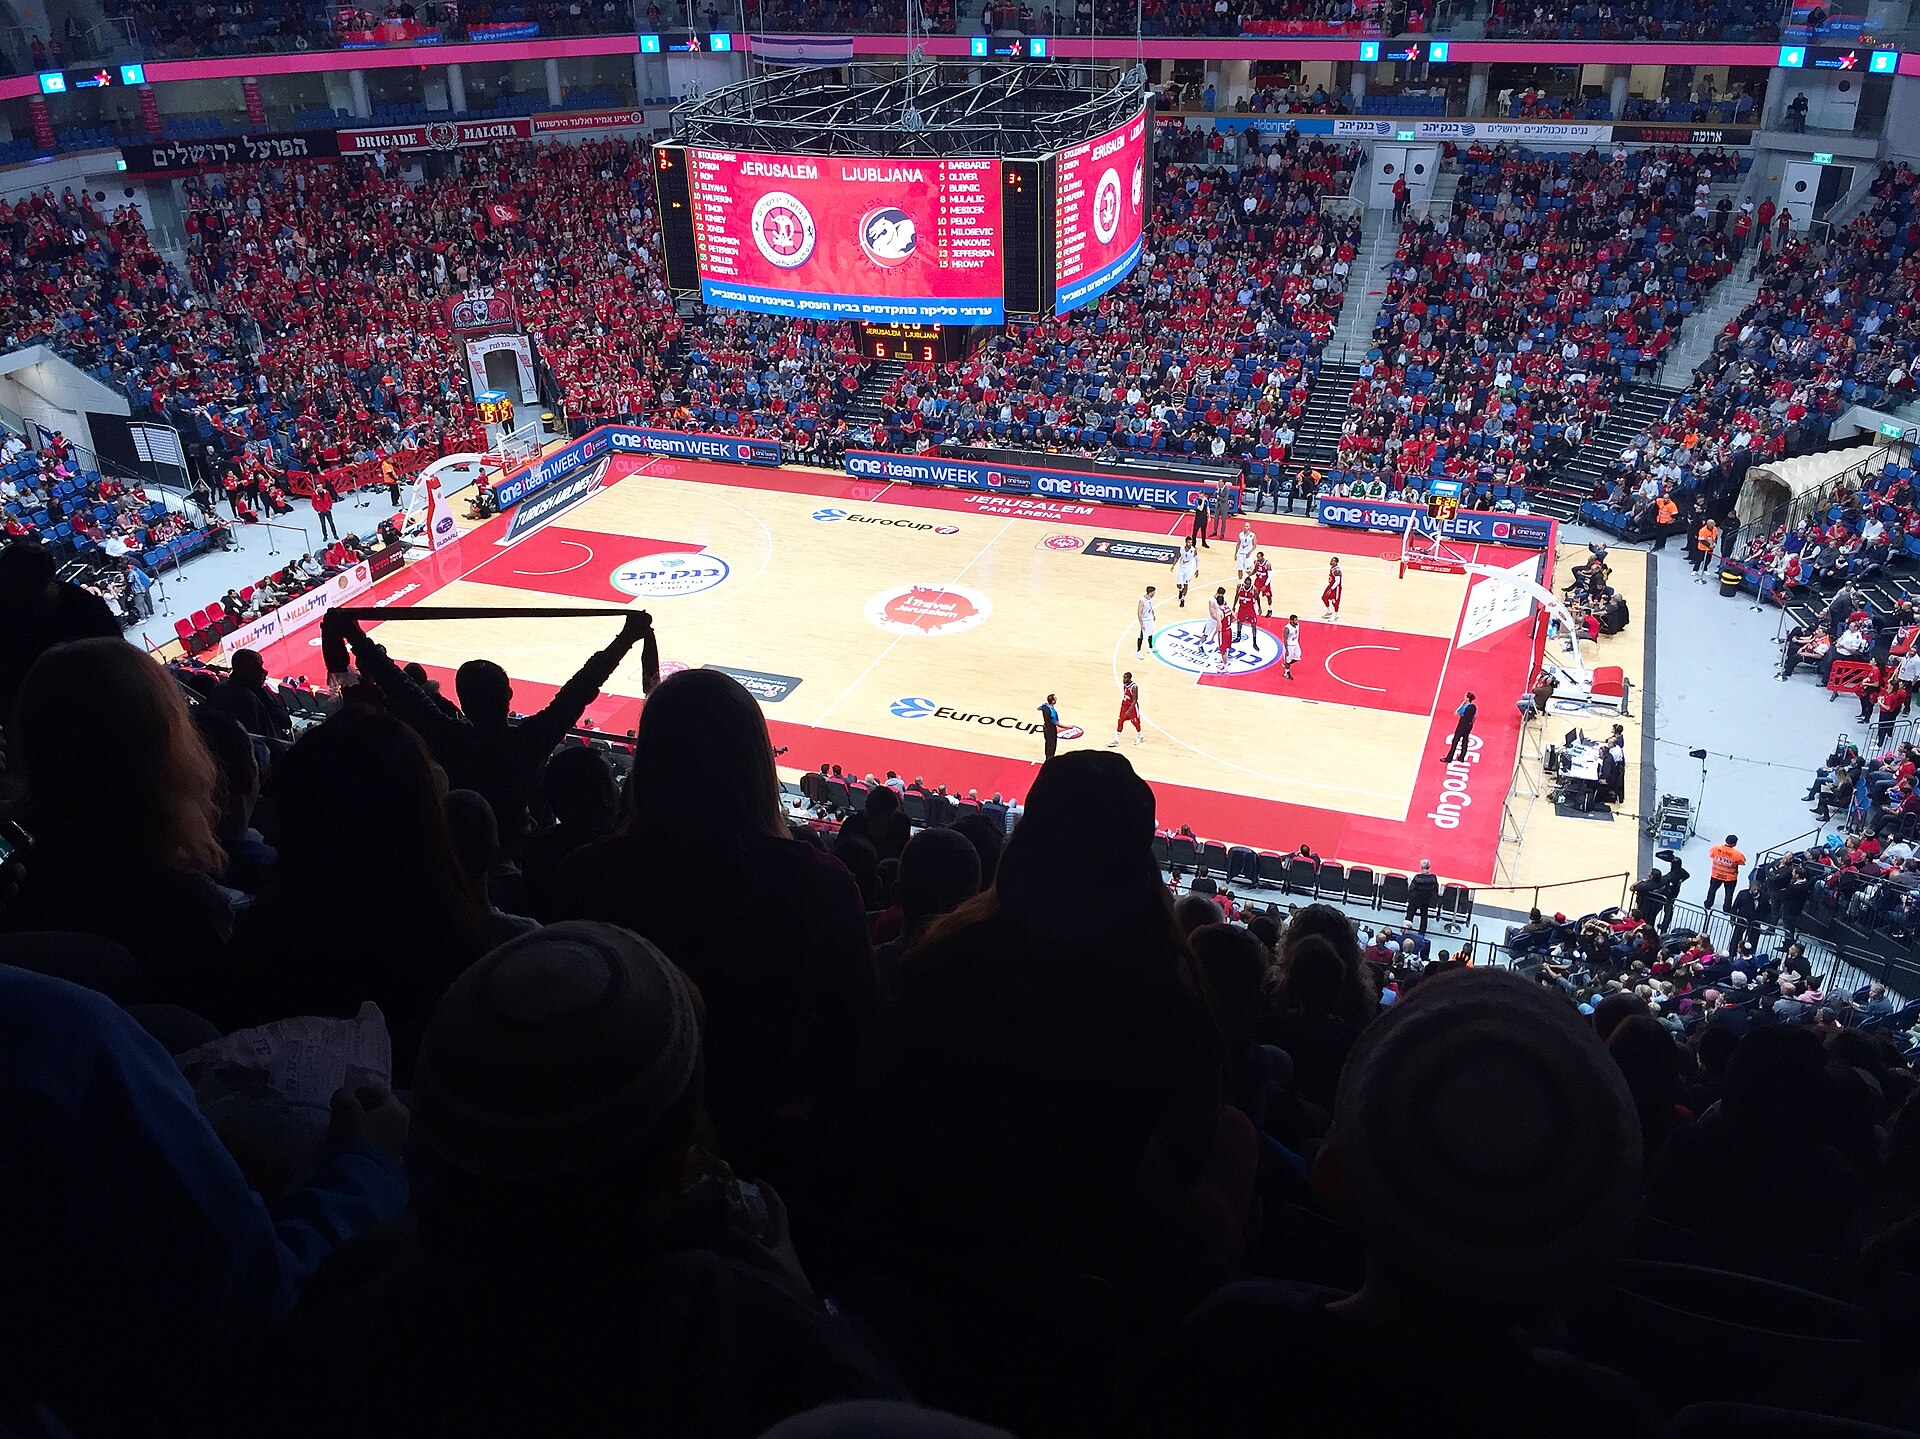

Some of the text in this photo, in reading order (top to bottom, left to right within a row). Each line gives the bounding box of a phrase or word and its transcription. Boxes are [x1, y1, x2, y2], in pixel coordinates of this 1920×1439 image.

[1434, 47, 1443, 58] 4
[1788, 52, 1798, 64] 4
[1876, 57, 1887, 69] 5
[1339, 121, 1375, 131] בנק יהב
[1422, 123, 1459, 133] בנק יהב
[1488, 124, 1522, 134] ירושלים
[1571, 126, 1589, 135] גנים
[355, 124, 517, 149] BRIGADE MALCHA
[1692, 129, 1722, 143] ארומה
[152, 134, 308, 167] הפועל ירושלים
[698, 151, 737, 162] STOUDEMIRE
[660, 160, 667, 169] 2
[740, 161, 818, 180] JERUSALEM
[939, 162, 991, 170] 4 BARBARIC
[842, 167, 924, 183] LJUBLJANA
[939, 173, 978, 181] 5 OLIVER
[1009, 174, 1015, 184] 3
[702, 194, 732, 204] HALPERIN
[950, 195, 985, 203] MULALIC
[704, 204, 724, 213] TIMOR
[706, 225, 724, 234] JONES
[938, 228, 994, 236] 11 MILOSEVIC
[707, 234, 740, 245] THOMPSON
[938, 239, 991, 247] 12 JANKOVIC
[708, 244, 739, 255] PETERSON
[939, 250, 995, 258] 13 JEFFERSON
[462, 287, 495, 302] 1312
[833, 302, 860, 313] בבית
[863, 304, 918, 317] מתקדמים
[920, 306, 958, 316] סליקה
[960, 307, 992, 316] ערוצי
[876, 342, 885, 357] 6
[924, 347, 933, 361] 3
[485, 411, 494, 421] 15
[612, 433, 642, 448] one
[647, 436, 685, 452] team
[686, 441, 731, 457] WEEK
[500, 484, 522, 504] one
[551, 450, 581, 476] WEEK
[850, 458, 980, 484] one team WEEK
[1038, 477, 1178, 505] one team WEEK
[964, 494, 1094, 515] JERUSALEM
[1436, 496, 1457, 507] 6:26
[516, 494, 557, 528] TURKISH
[978, 506, 1062, 520] PAIS ARENA
[1438, 506, 1451, 518] 15
[847, 514, 933, 532] EuroCup
[1324, 506, 1363, 524] one
[1423, 517, 1483, 536] WEEK
[437, 532, 458, 548] SUBARU
[621, 569, 719, 581] בנק יהב
[895, 605, 958, 618] Jerusalem
[934, 707, 1046, 735] EuroCup
